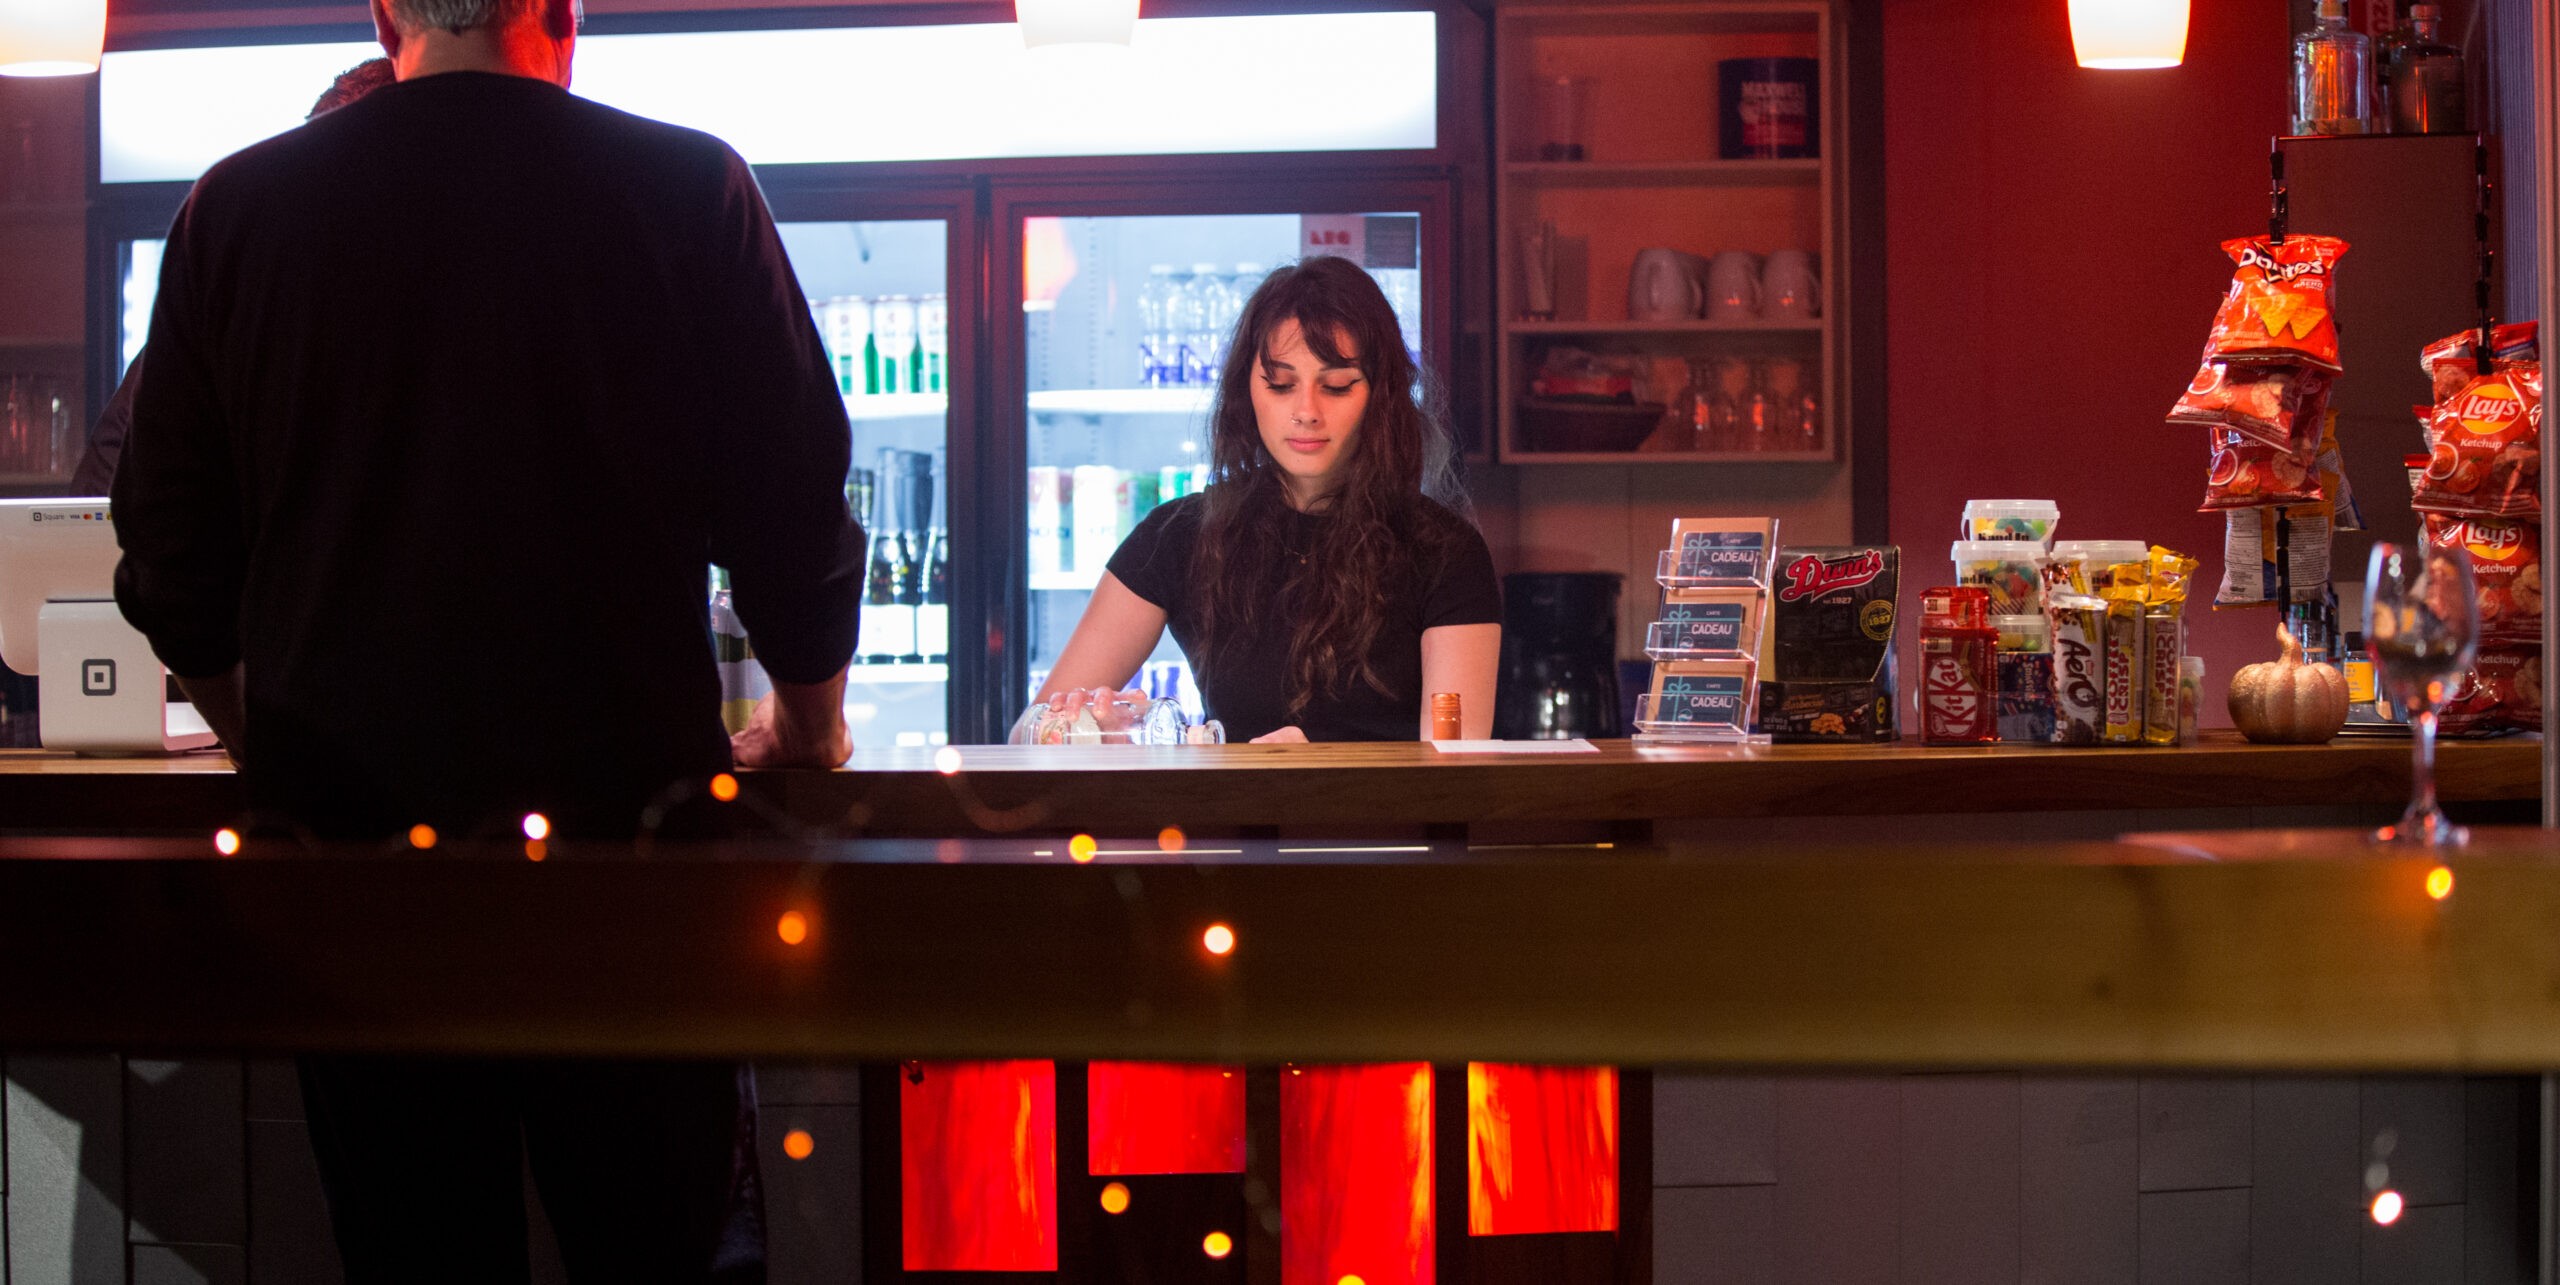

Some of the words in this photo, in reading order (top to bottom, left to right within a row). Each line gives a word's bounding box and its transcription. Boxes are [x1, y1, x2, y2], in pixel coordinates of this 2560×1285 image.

[2462, 395, 2519, 423] Lay's
[2460, 438, 2503, 451] Ketchup
[2465, 522, 2517, 548] Lay's
[1711, 551, 1754, 563] CADEAU
[1780, 549, 1884, 603] Dunn's
[2472, 563, 2517, 576] Ketchup
[1691, 624, 1733, 635] CADEAU
[2155, 634, 2165, 694] CRISP
[2476, 651, 2520, 666] Ketchup
[1690, 696, 1734, 708] CADEAU
